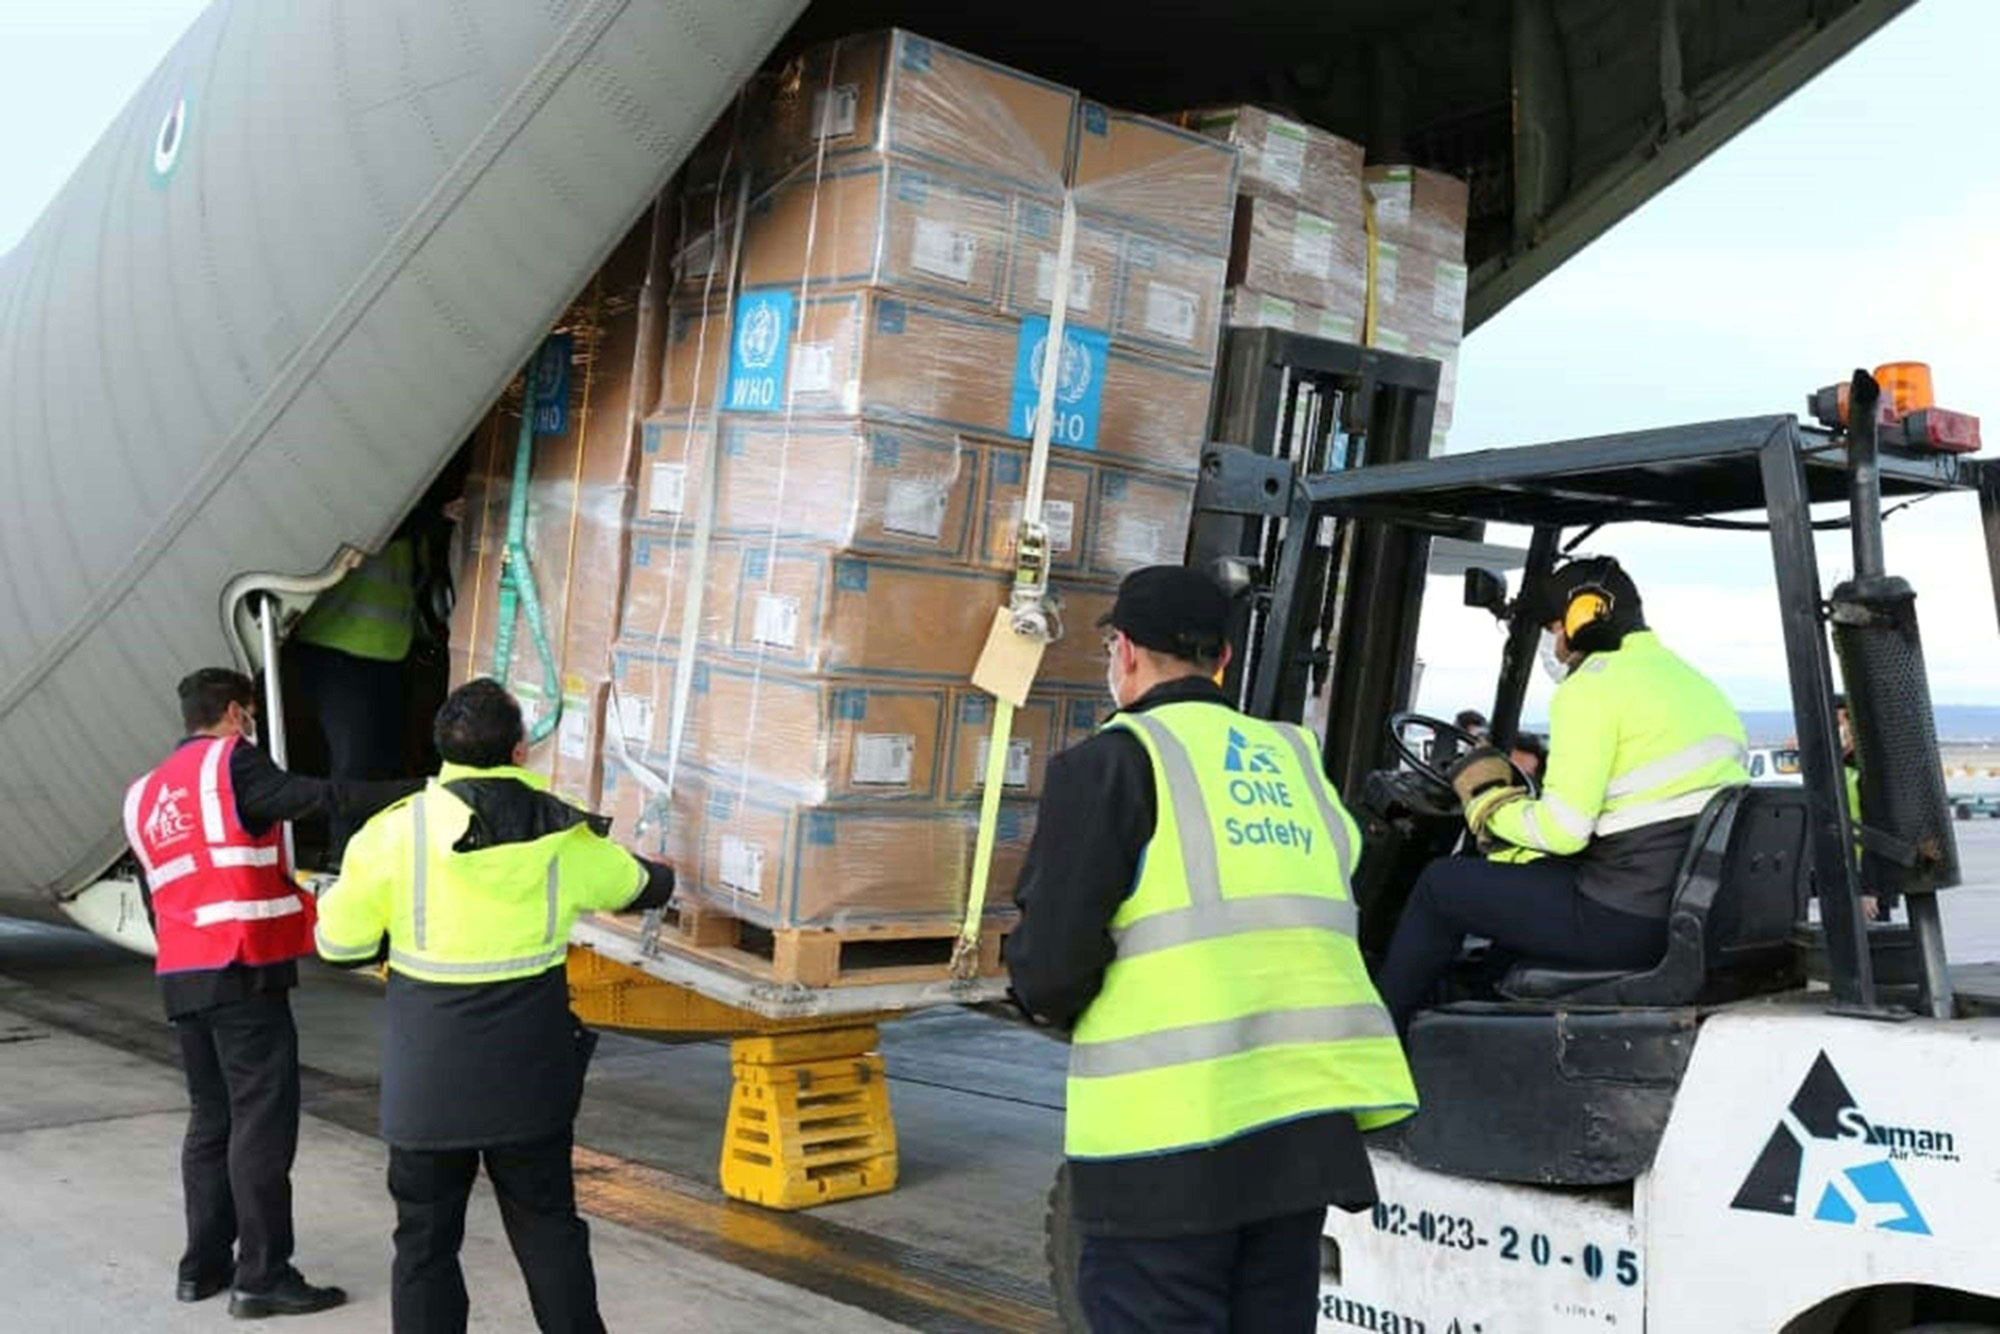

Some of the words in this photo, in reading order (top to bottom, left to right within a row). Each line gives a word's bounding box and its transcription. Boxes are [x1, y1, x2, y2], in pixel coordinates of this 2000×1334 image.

[733, 377, 775, 406] WHO
[1229, 779, 1293, 807] ONE
[1225, 816, 1312, 855] Safety
[1316, 1294, 1426, 1334] aman
